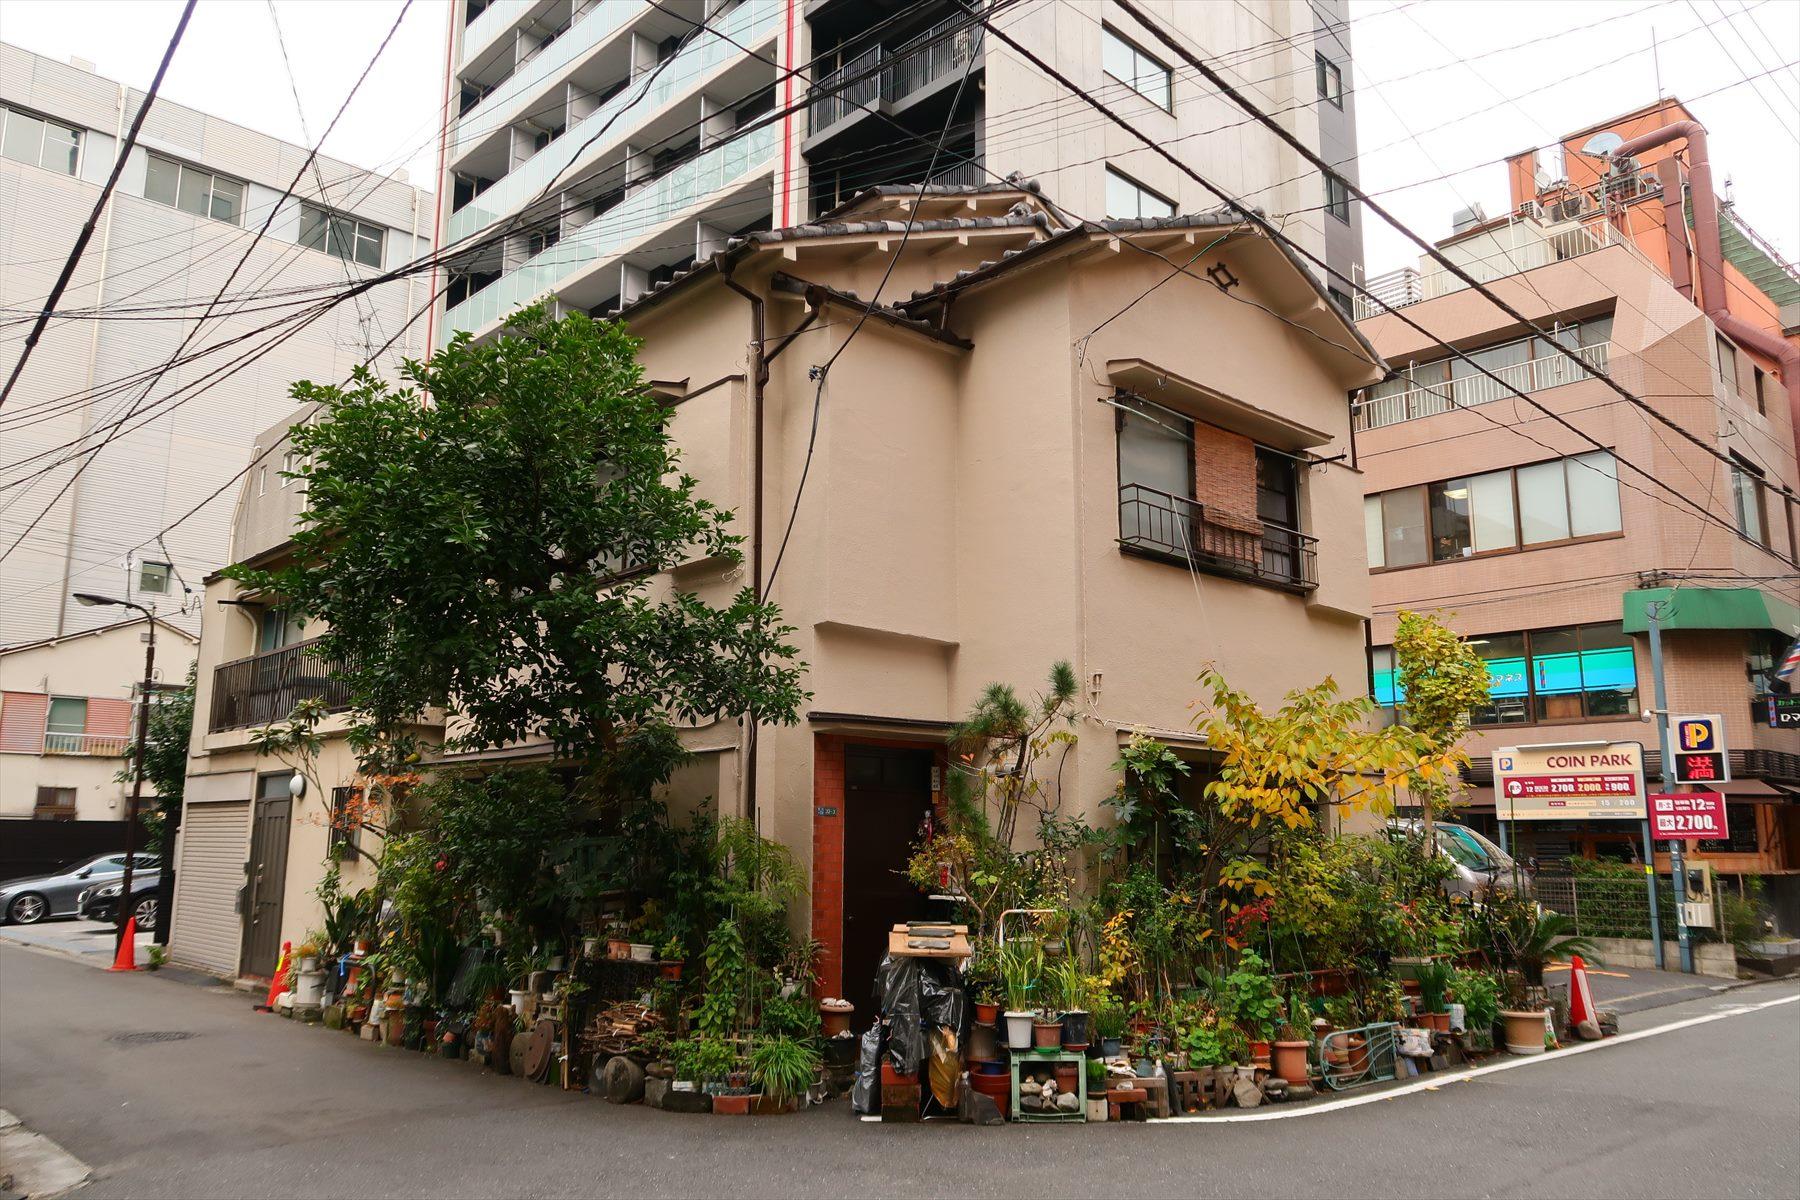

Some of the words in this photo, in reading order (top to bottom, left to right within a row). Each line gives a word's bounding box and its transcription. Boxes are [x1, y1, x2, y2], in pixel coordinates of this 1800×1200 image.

[1688, 723, 1709, 748] P
[1547, 756, 1585, 768] COIN
[1591, 754, 1632, 767] PARK
[1687, 756, 1714, 779] 満
[1689, 798, 1706, 810] 12
